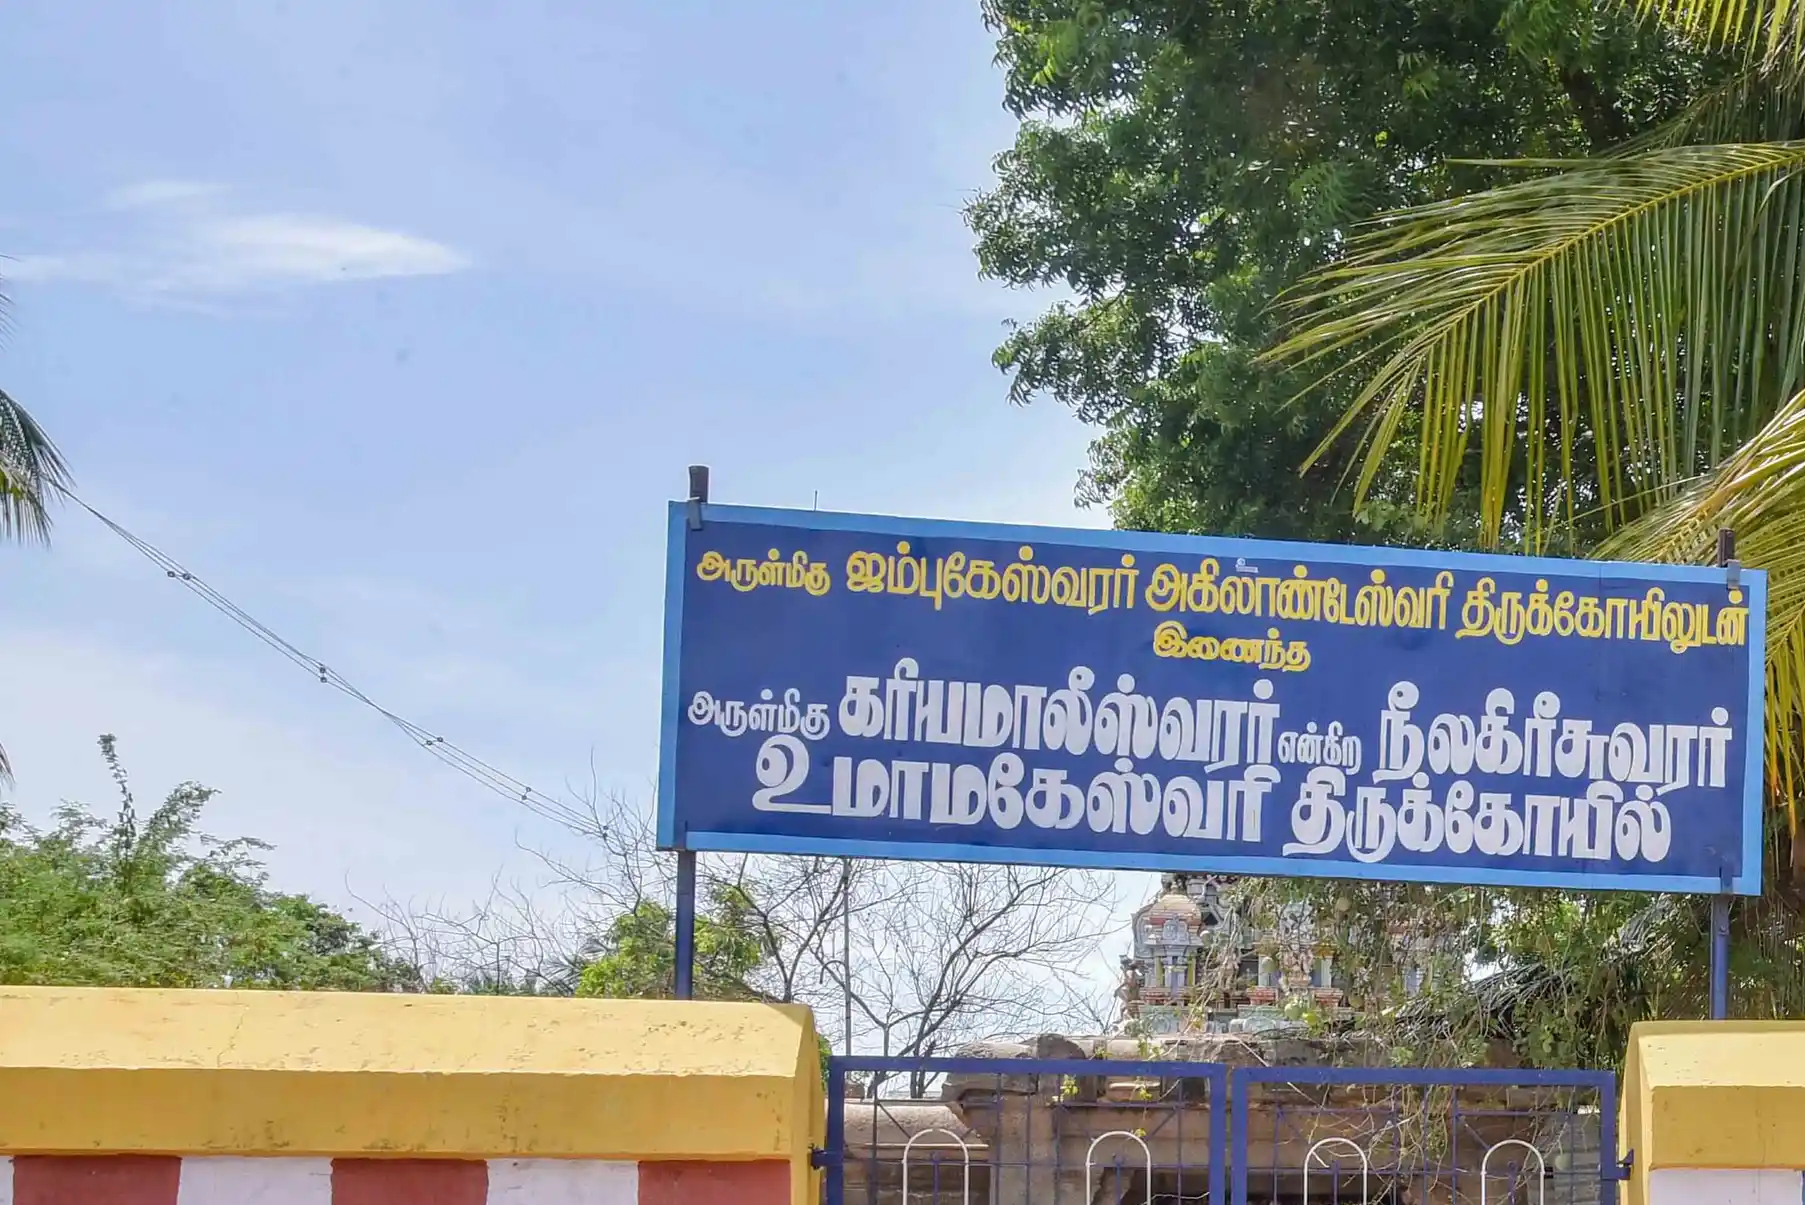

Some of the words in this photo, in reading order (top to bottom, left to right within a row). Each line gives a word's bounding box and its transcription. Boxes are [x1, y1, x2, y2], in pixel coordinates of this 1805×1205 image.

[697, 547, 831, 597] அருள்மிகு
[846, 540, 1140, 616] ஜம்புகேஸ்வரர்
[1145, 557, 1455, 631] அகிலாண்டேஸ்வரி
[1455, 577, 1750, 655] திருக்கோயிலுடன்
[1153, 620, 1312, 673] இணைந்த
[687, 687, 831, 742] அருள்மிகு
[1277, 721, 1363, 776] என்கிற
[1282, 766, 1672, 864] திருக்கோயில்
